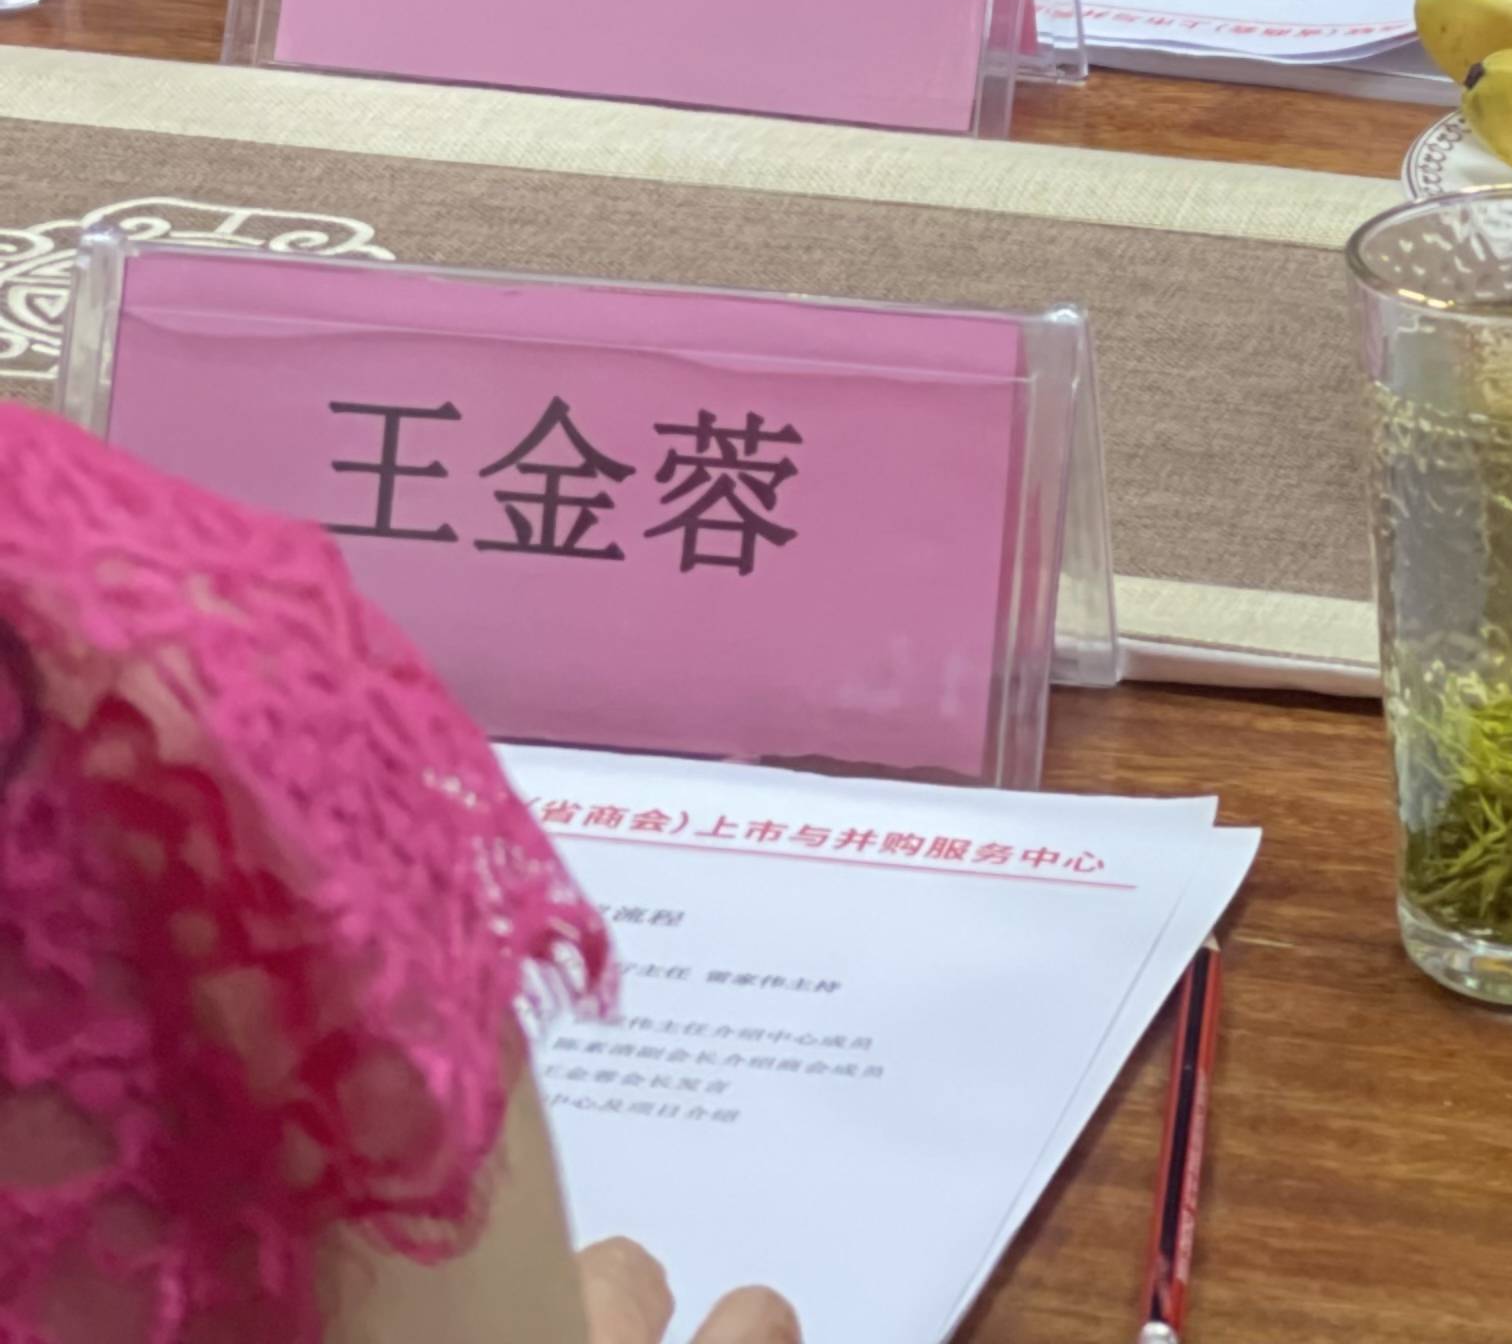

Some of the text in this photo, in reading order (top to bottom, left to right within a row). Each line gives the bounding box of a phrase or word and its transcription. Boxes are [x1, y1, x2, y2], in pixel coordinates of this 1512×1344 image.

[325, 395, 804, 576] 王金蓉
[600, 903, 685, 928] 流程
[592, 1012, 874, 1051] 伟主任介绍中心成员
